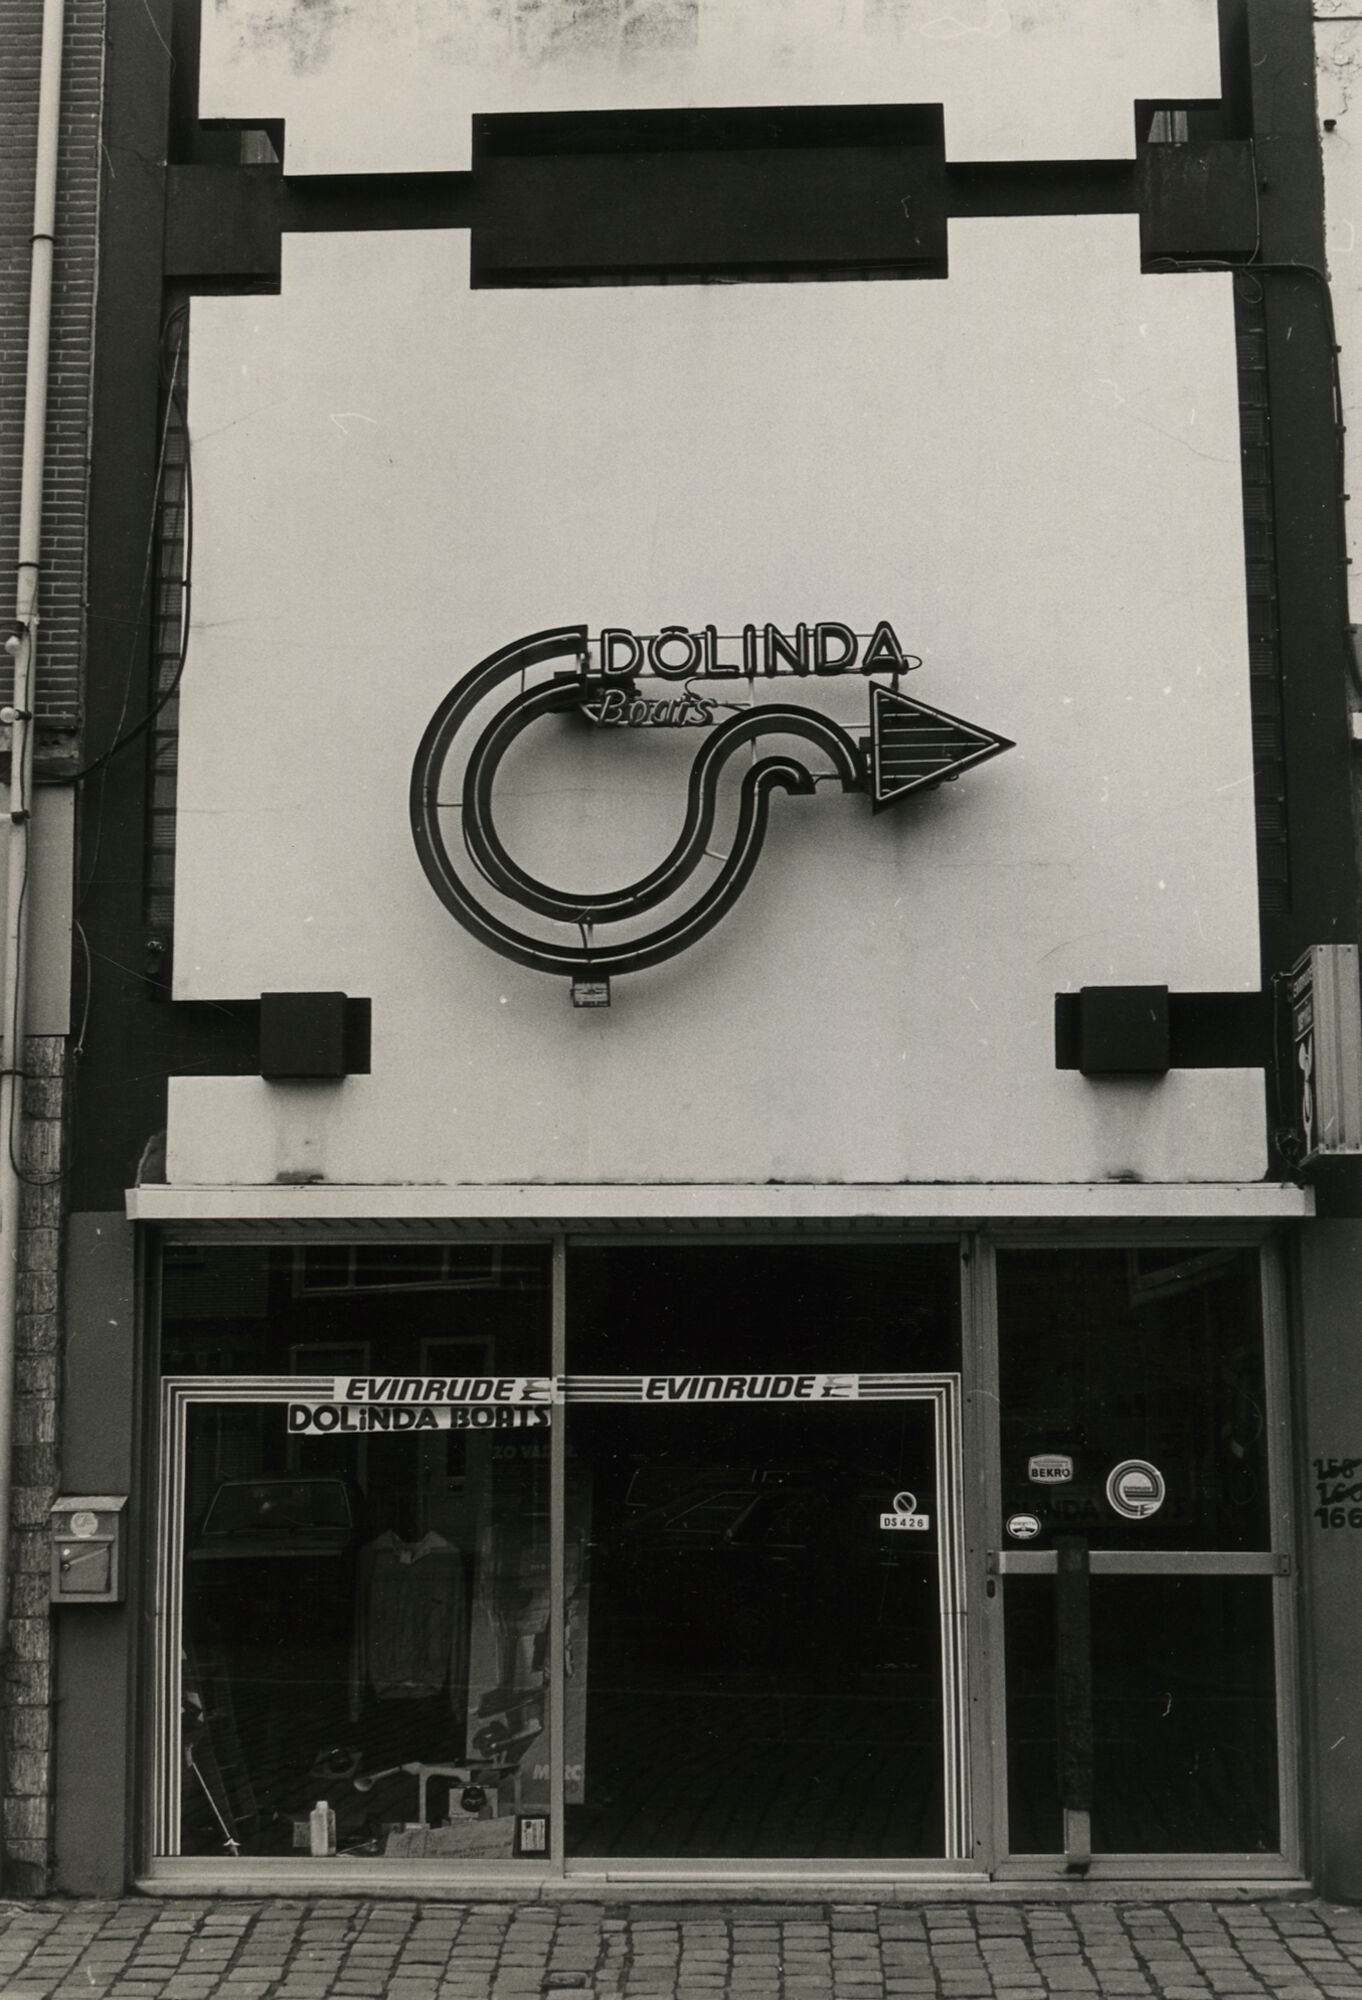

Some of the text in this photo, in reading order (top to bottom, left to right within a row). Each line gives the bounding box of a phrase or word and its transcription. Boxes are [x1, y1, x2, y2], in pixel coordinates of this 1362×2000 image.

[600, 620, 909, 681] DOLINDA
[599, 688, 718, 727] Boats
[345, 1378, 516, 1401] EVINRUDE
[645, 1375, 817, 1400] EVINRUDE
[450, 1406, 551, 1429] BOATS
[1031, 1468, 1071, 1478] BEKRO
[532, 1763, 582, 1781] MRC
